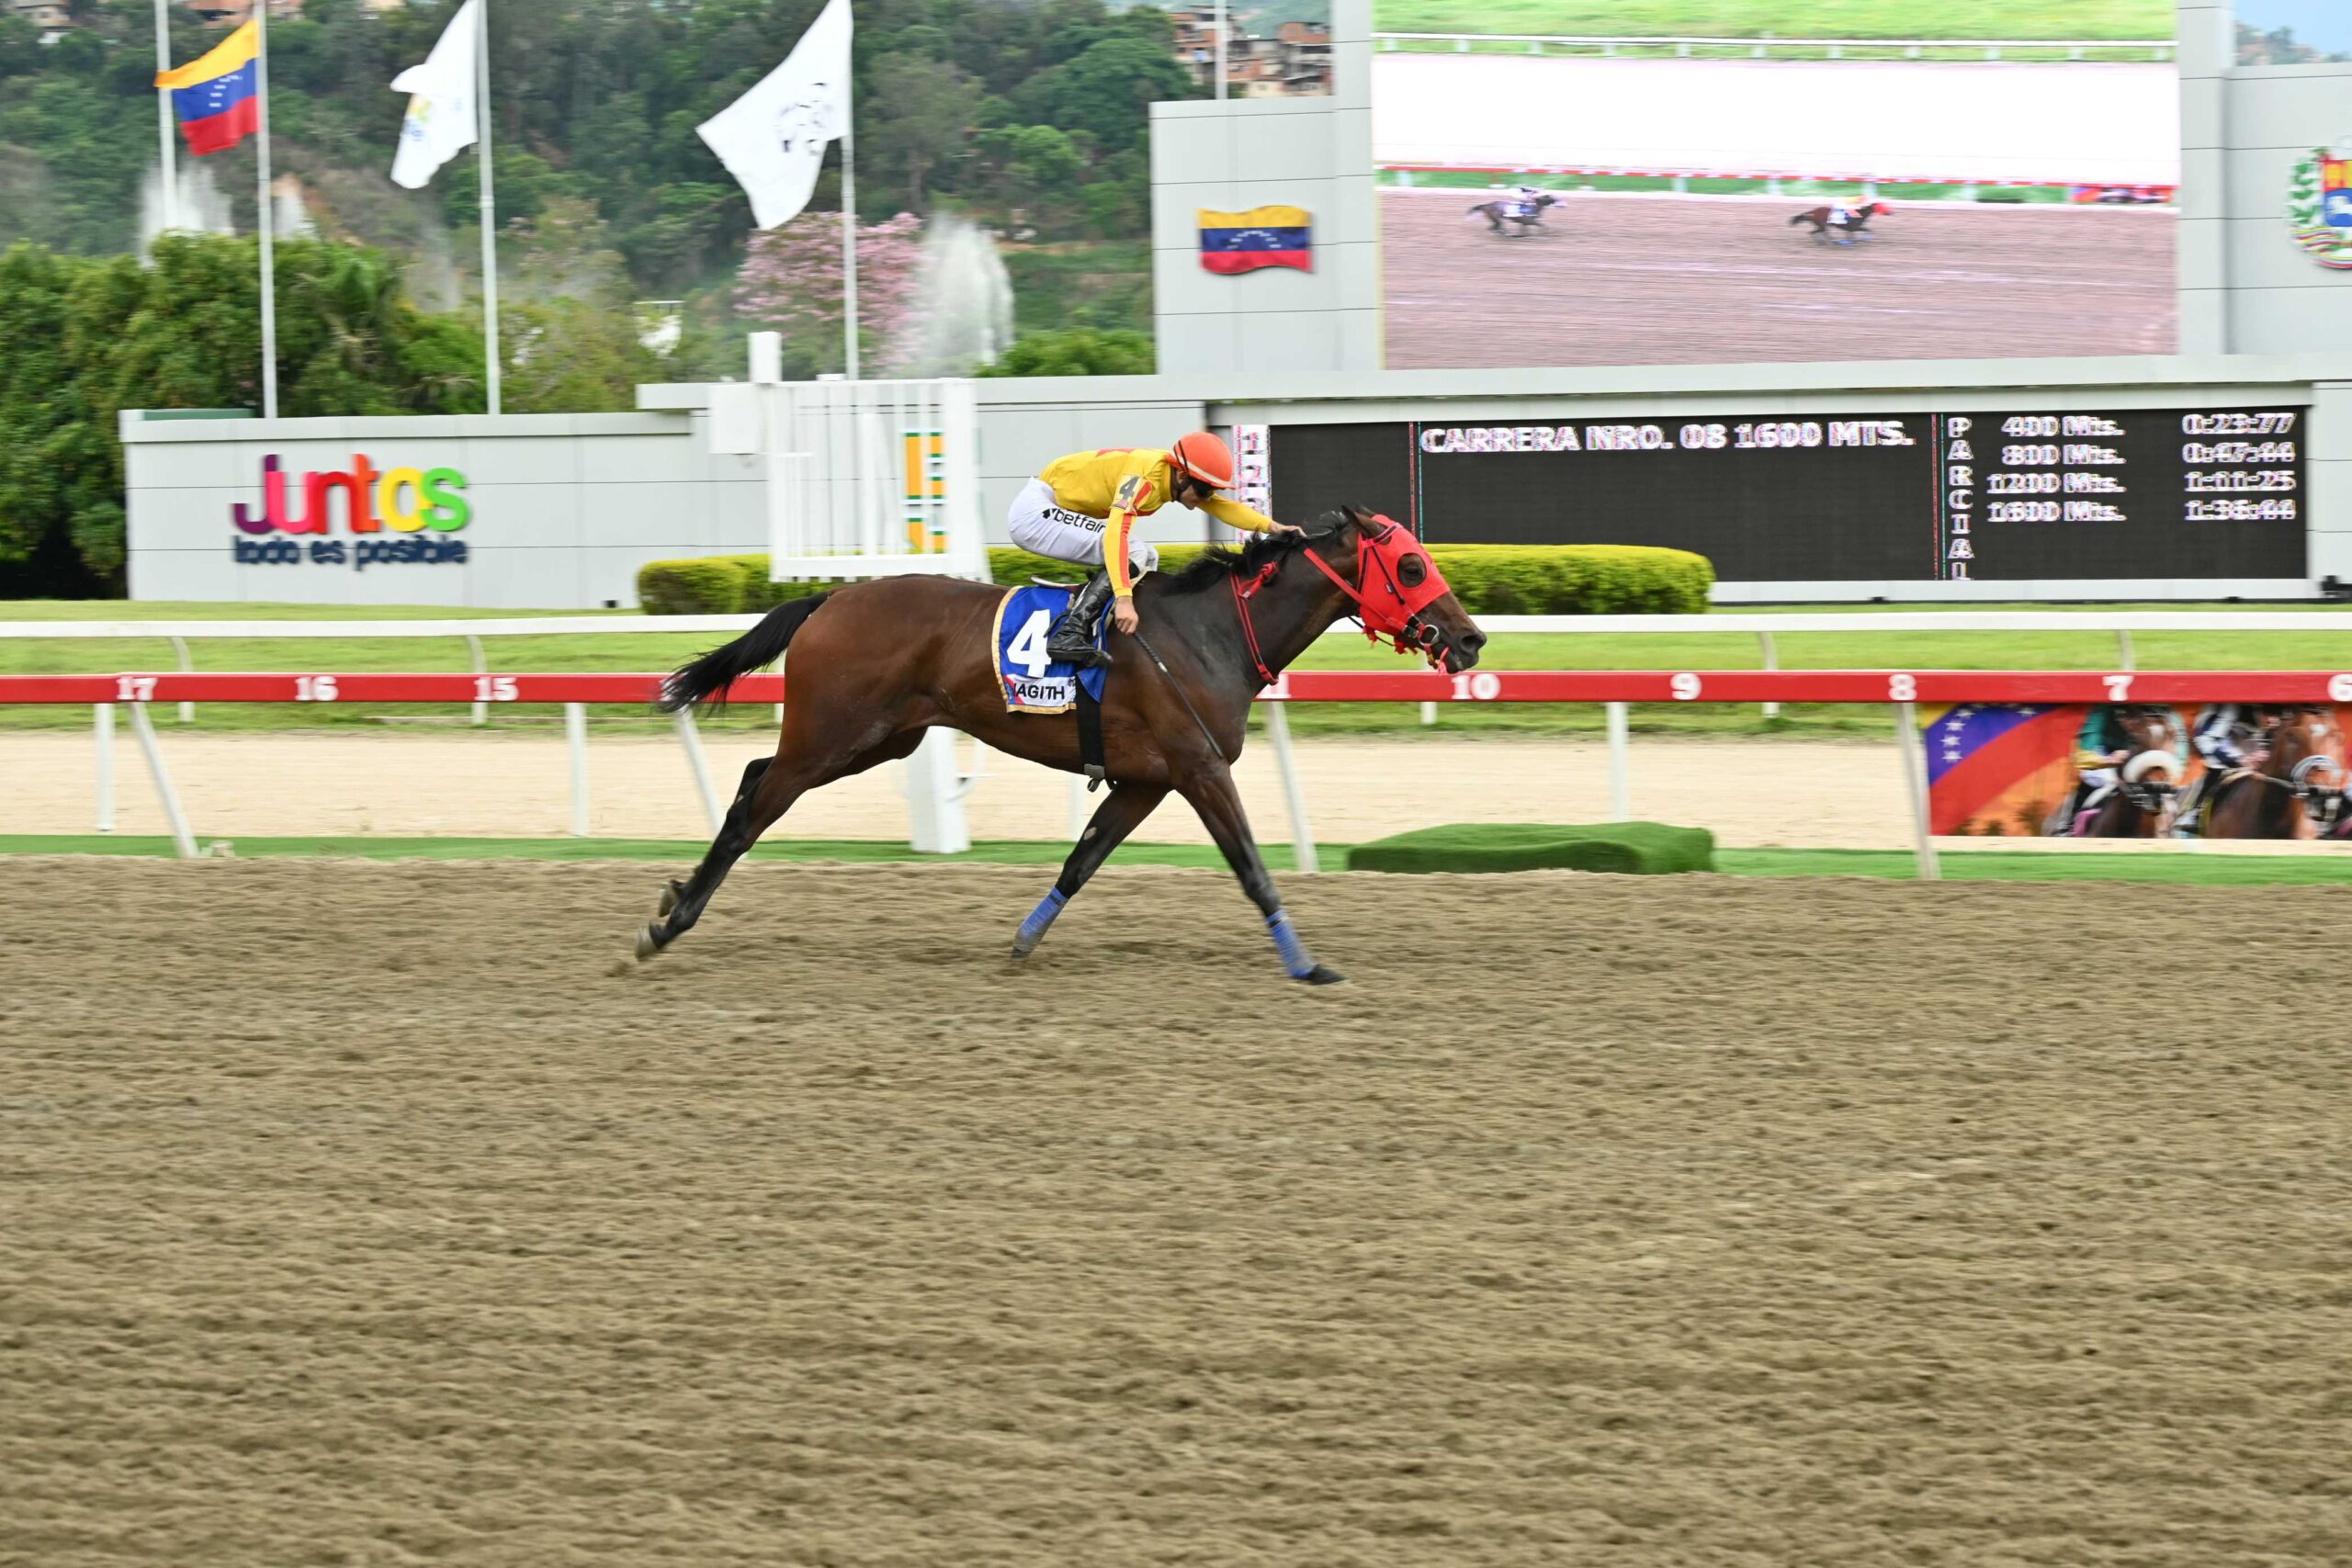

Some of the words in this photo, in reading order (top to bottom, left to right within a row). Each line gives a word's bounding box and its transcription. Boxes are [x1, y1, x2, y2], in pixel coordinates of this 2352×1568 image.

[1421, 426, 1582, 453] CARRERA
[1585, 424, 1676, 451] NRO.
[1679, 423, 1729, 449] 08
[1733, 422, 1822, 448] 1600
[1827, 420, 1917, 446] MTS.
[2001, 416, 2061, 436] 400
[2182, 413, 2296, 434] 0:23:77
[2002, 445, 2061, 465] 800
[1119, 476, 1141, 502] 4
[1986, 473, 2062, 493] 1200
[1054, 508, 1106, 534] betfair
[309, 540, 346, 564] es
[353, 534, 469, 571] posible
[1007, 608, 1052, 678] 4
[117, 677, 158, 700] 17
[295, 676, 339, 701] 16
[474, 677, 520, 701] 15
[1451, 672, 1501, 700] 10
[1670, 672, 1702, 700] 9
[1888, 673, 1917, 700] 8
[2103, 675, 2133, 701] 7
[2328, 674, 2352, 701] 6
